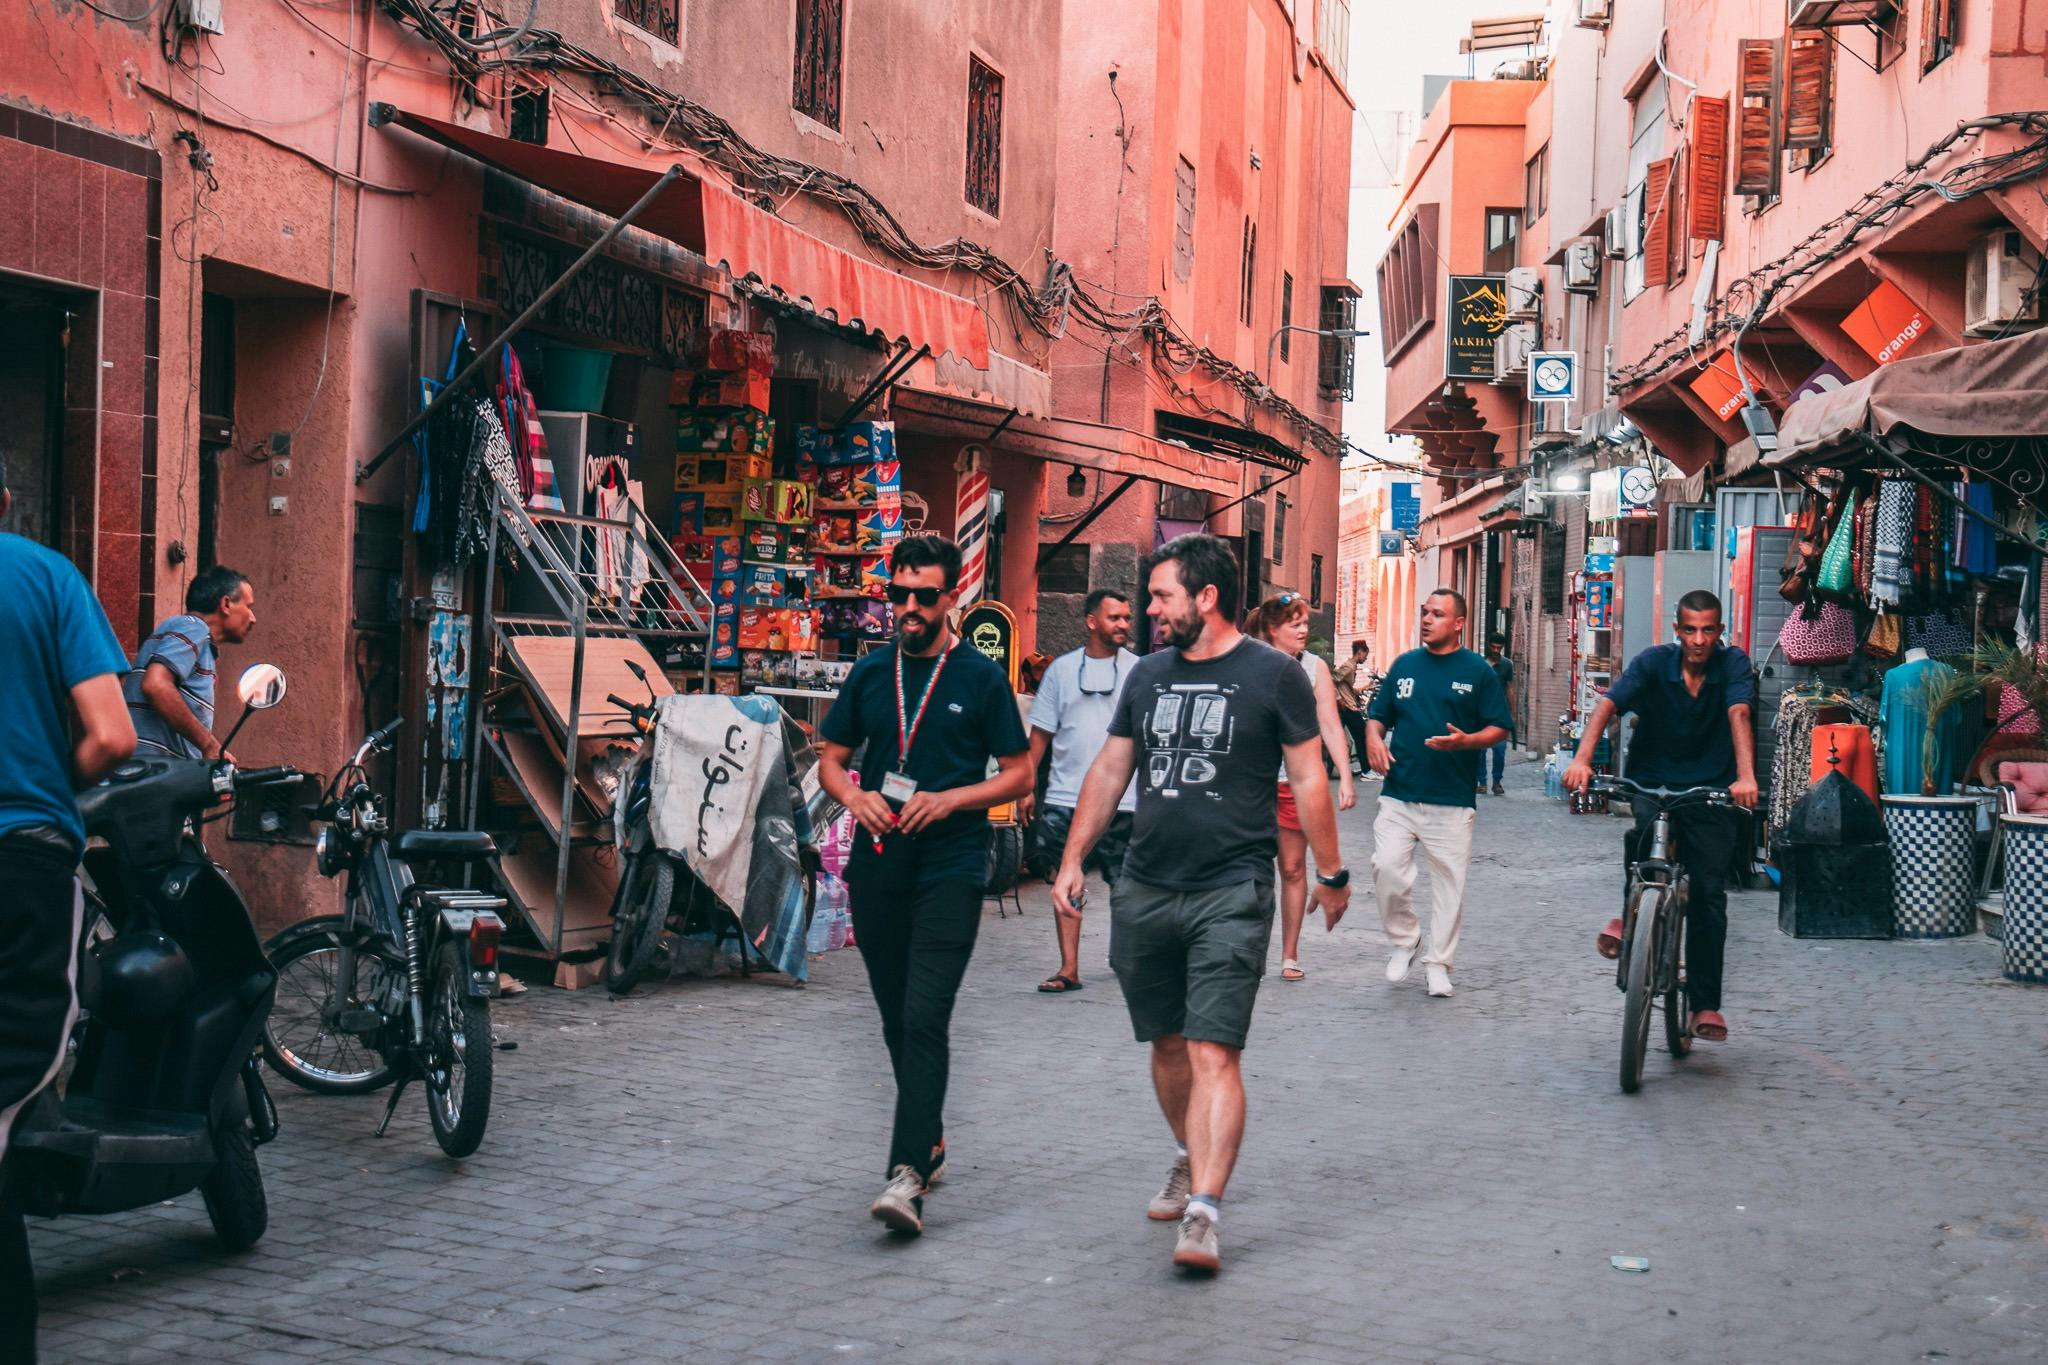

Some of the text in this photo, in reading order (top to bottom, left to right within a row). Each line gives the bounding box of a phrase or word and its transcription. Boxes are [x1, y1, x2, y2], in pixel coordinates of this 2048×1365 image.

[1878, 317, 1922, 363] orange
[756, 545, 777, 554] FRITA
[755, 572, 776, 581] FRITA
[1396, 677, 1415, 699] 38
[697, 724, 747, 858] سنوات
